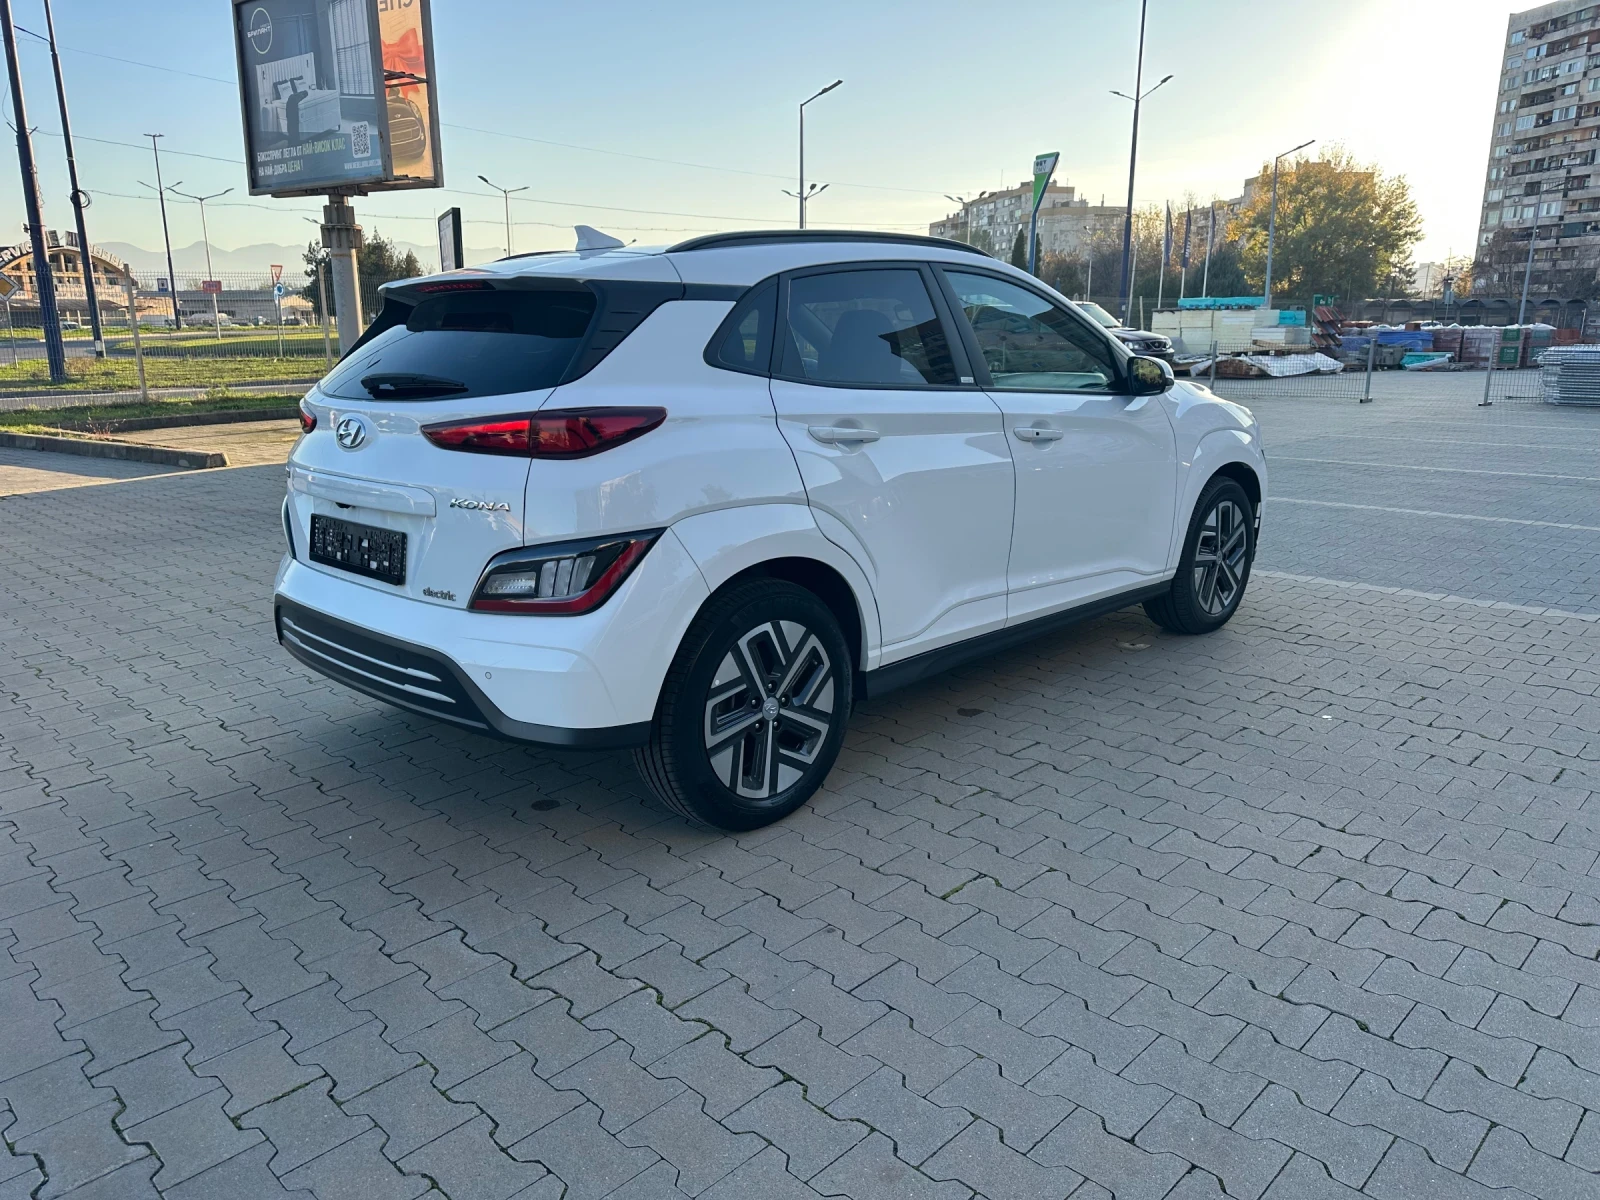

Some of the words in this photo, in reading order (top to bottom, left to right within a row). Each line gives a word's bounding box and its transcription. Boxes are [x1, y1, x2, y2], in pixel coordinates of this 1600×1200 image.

[283, 146, 297, 159] ЛЕГЛА
[297, 145, 303, 157] ОТ
[302, 140, 332, 155] НАЙ-ВИСОК
[331, 138, 346, 152] КЛАС
[258, 166, 265, 177] НА
[265, 163, 288, 176] НАЙ-ДОБРА
[0, 240, 33, 263] RVIC
[450, 498, 511, 512] KONA
[422, 587, 457, 602] electric
